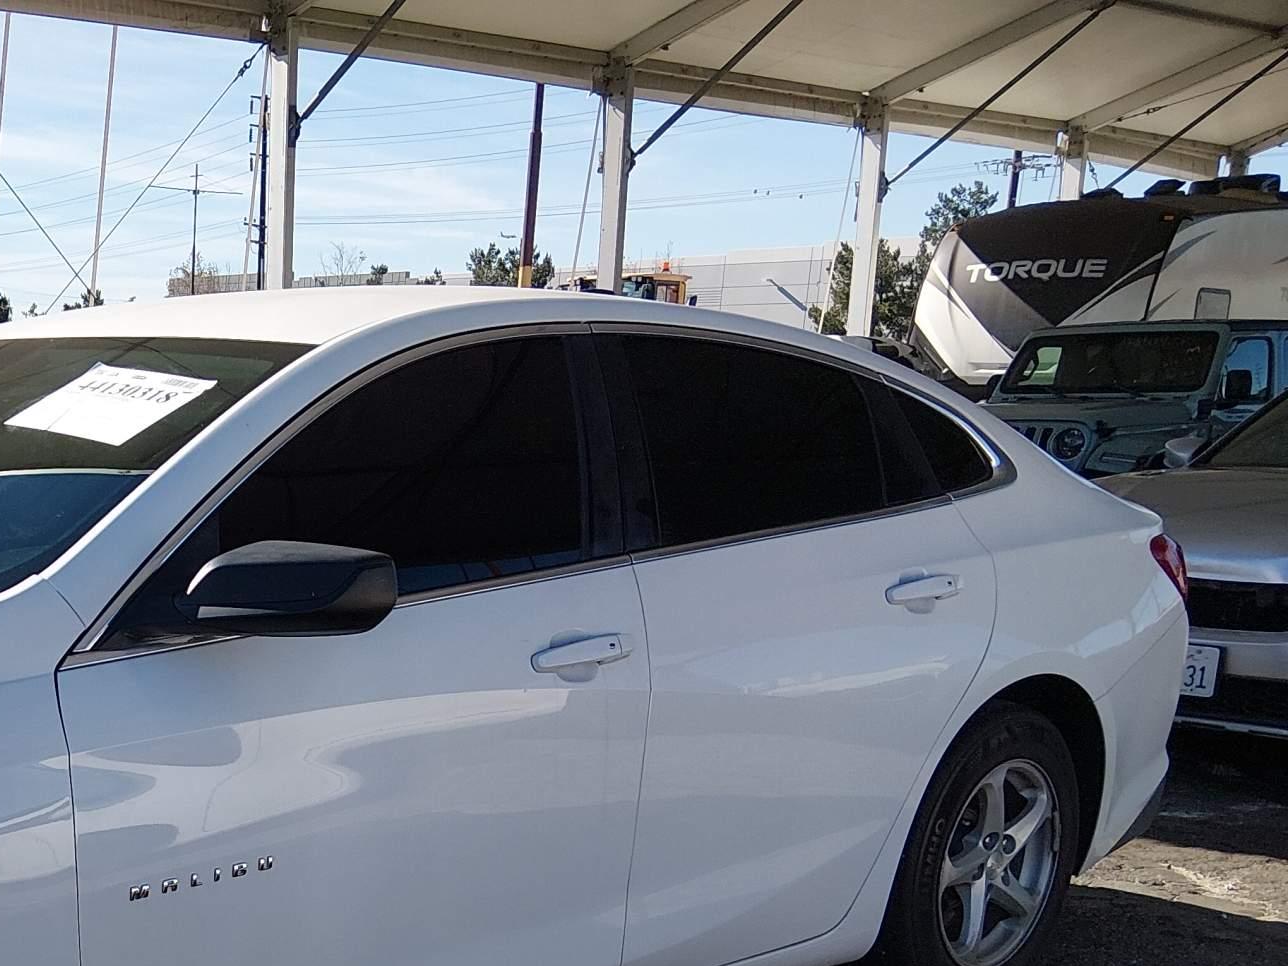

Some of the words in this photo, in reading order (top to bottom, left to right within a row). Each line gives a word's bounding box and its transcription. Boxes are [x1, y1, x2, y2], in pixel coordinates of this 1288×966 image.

[965, 258, 1108, 284] TORQUE
[78, 380, 179, 404] 44130318
[129, 855, 274, 902] MALIBU
